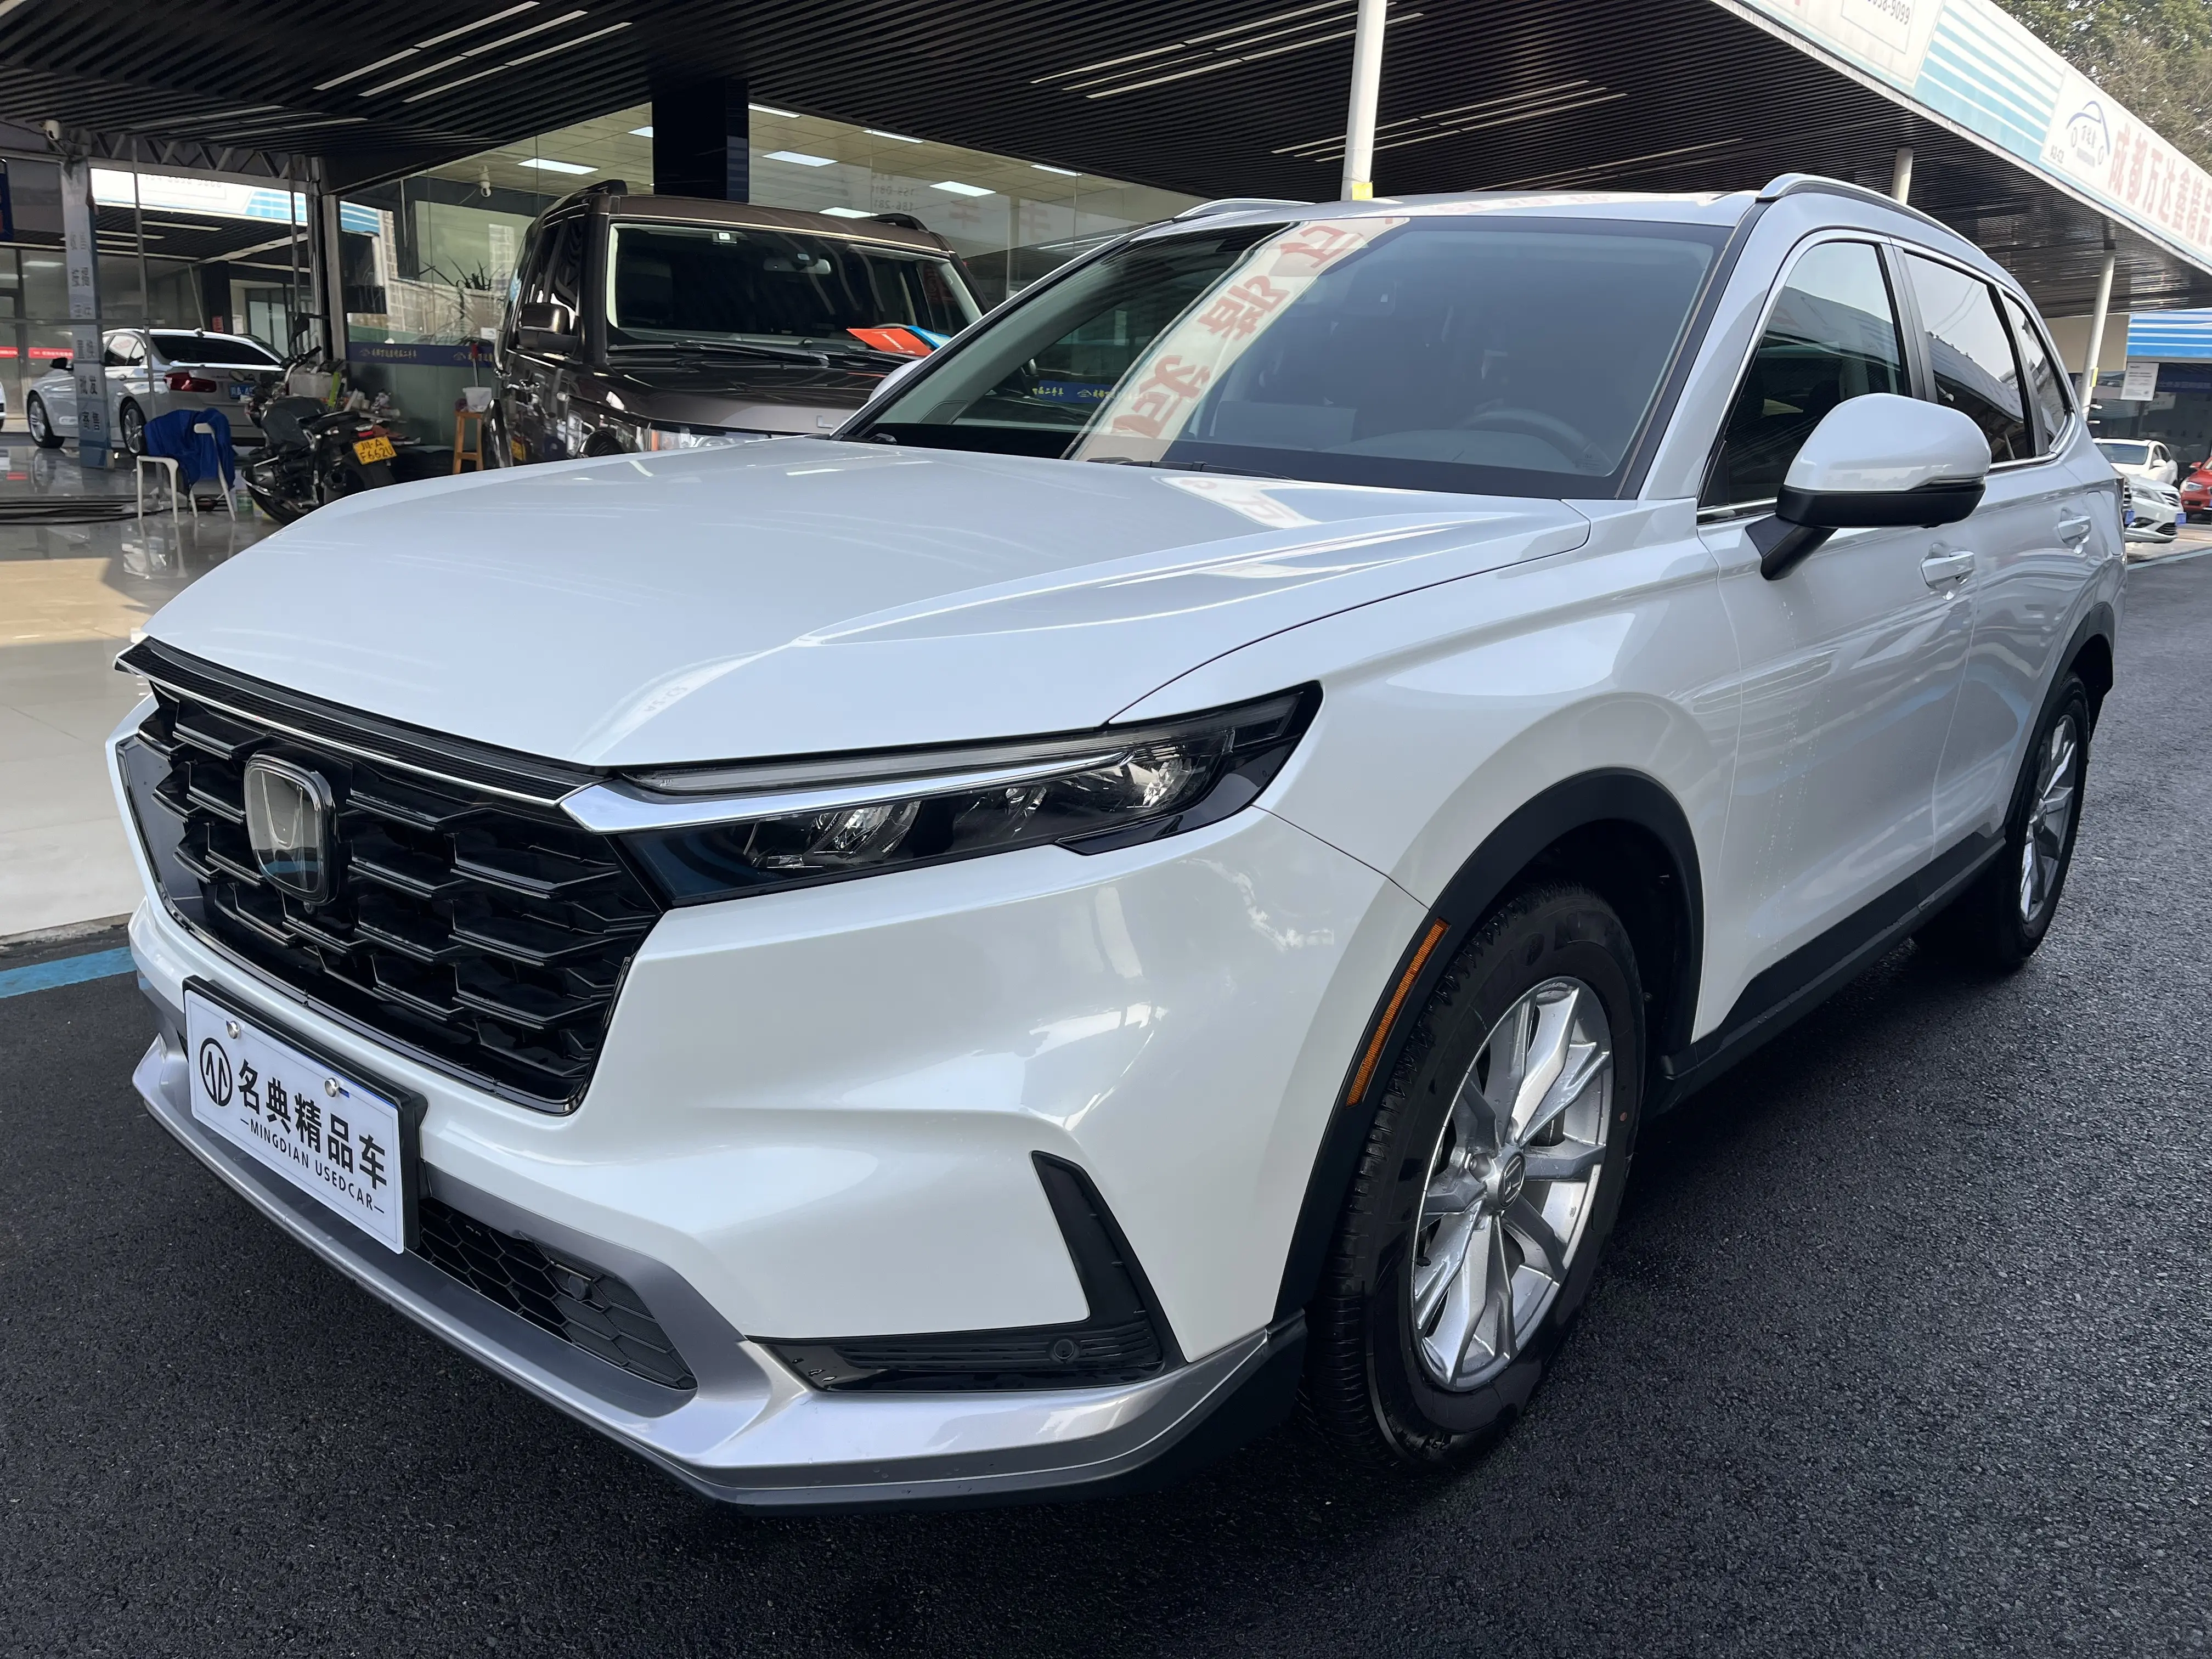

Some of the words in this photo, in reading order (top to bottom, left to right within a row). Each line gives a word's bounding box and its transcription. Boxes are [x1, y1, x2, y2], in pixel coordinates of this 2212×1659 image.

[2108, 122, 2212, 246] 成都万达鑫精品
[237, 1058, 387, 1190] 名典精品车
[251, 1118, 309, 1169] MINGDIAN
[315, 1159, 373, 1212] USEDCAR
